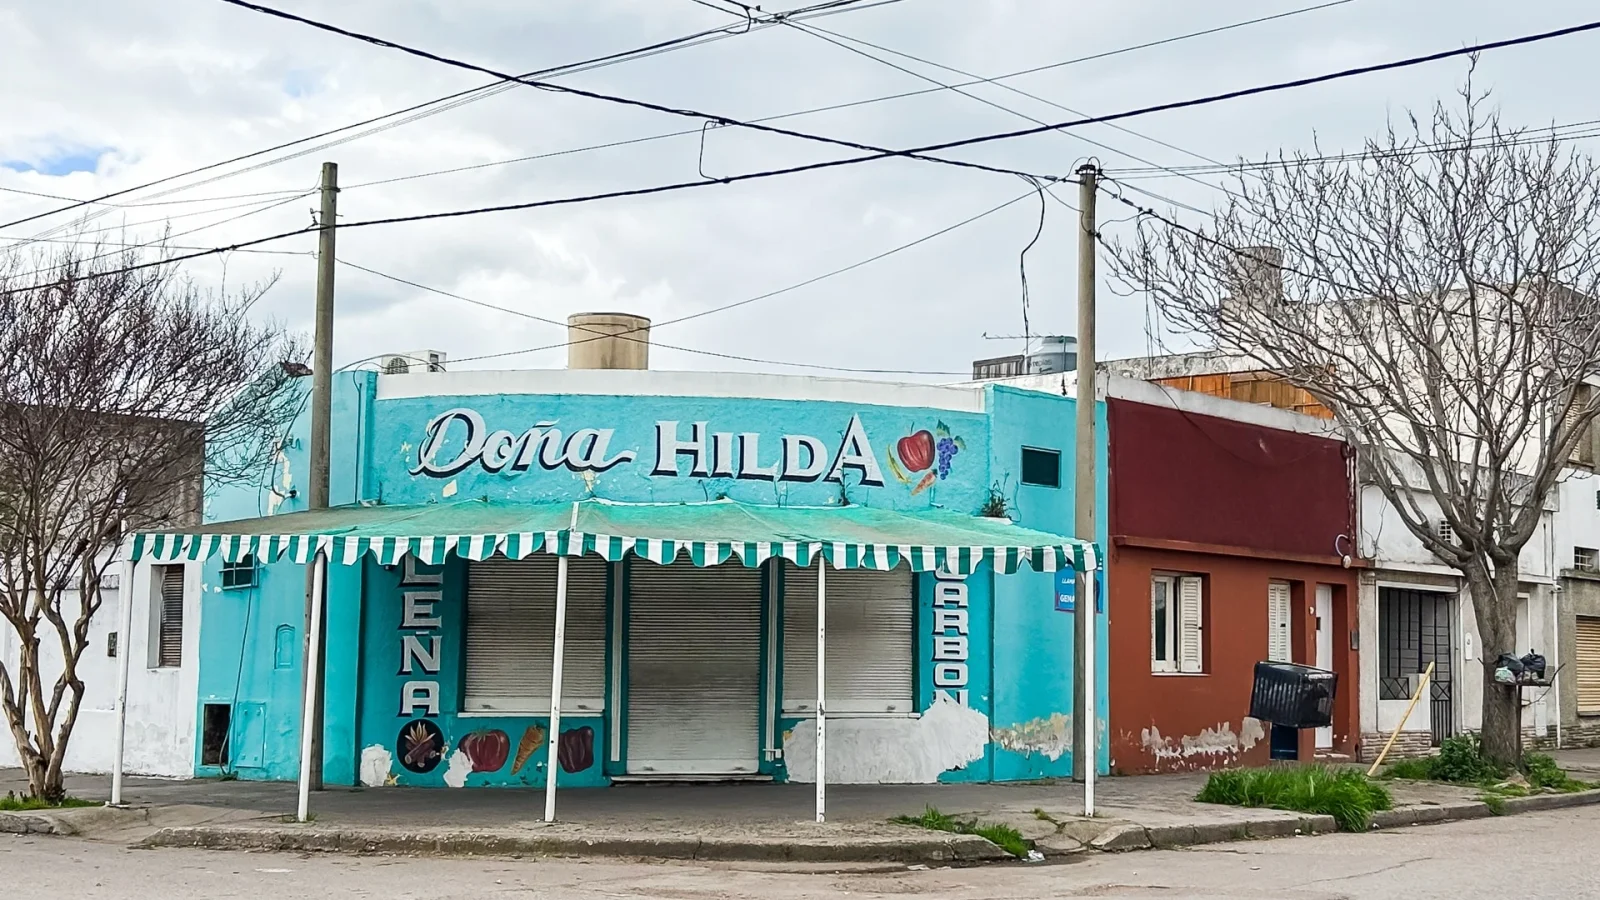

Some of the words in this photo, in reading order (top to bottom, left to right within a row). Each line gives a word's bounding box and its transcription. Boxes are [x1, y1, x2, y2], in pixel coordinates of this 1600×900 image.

[408, 408, 637, 478] Doña
[649, 412, 884, 487] HILDA
[397, 550, 443, 717] LEÑA
